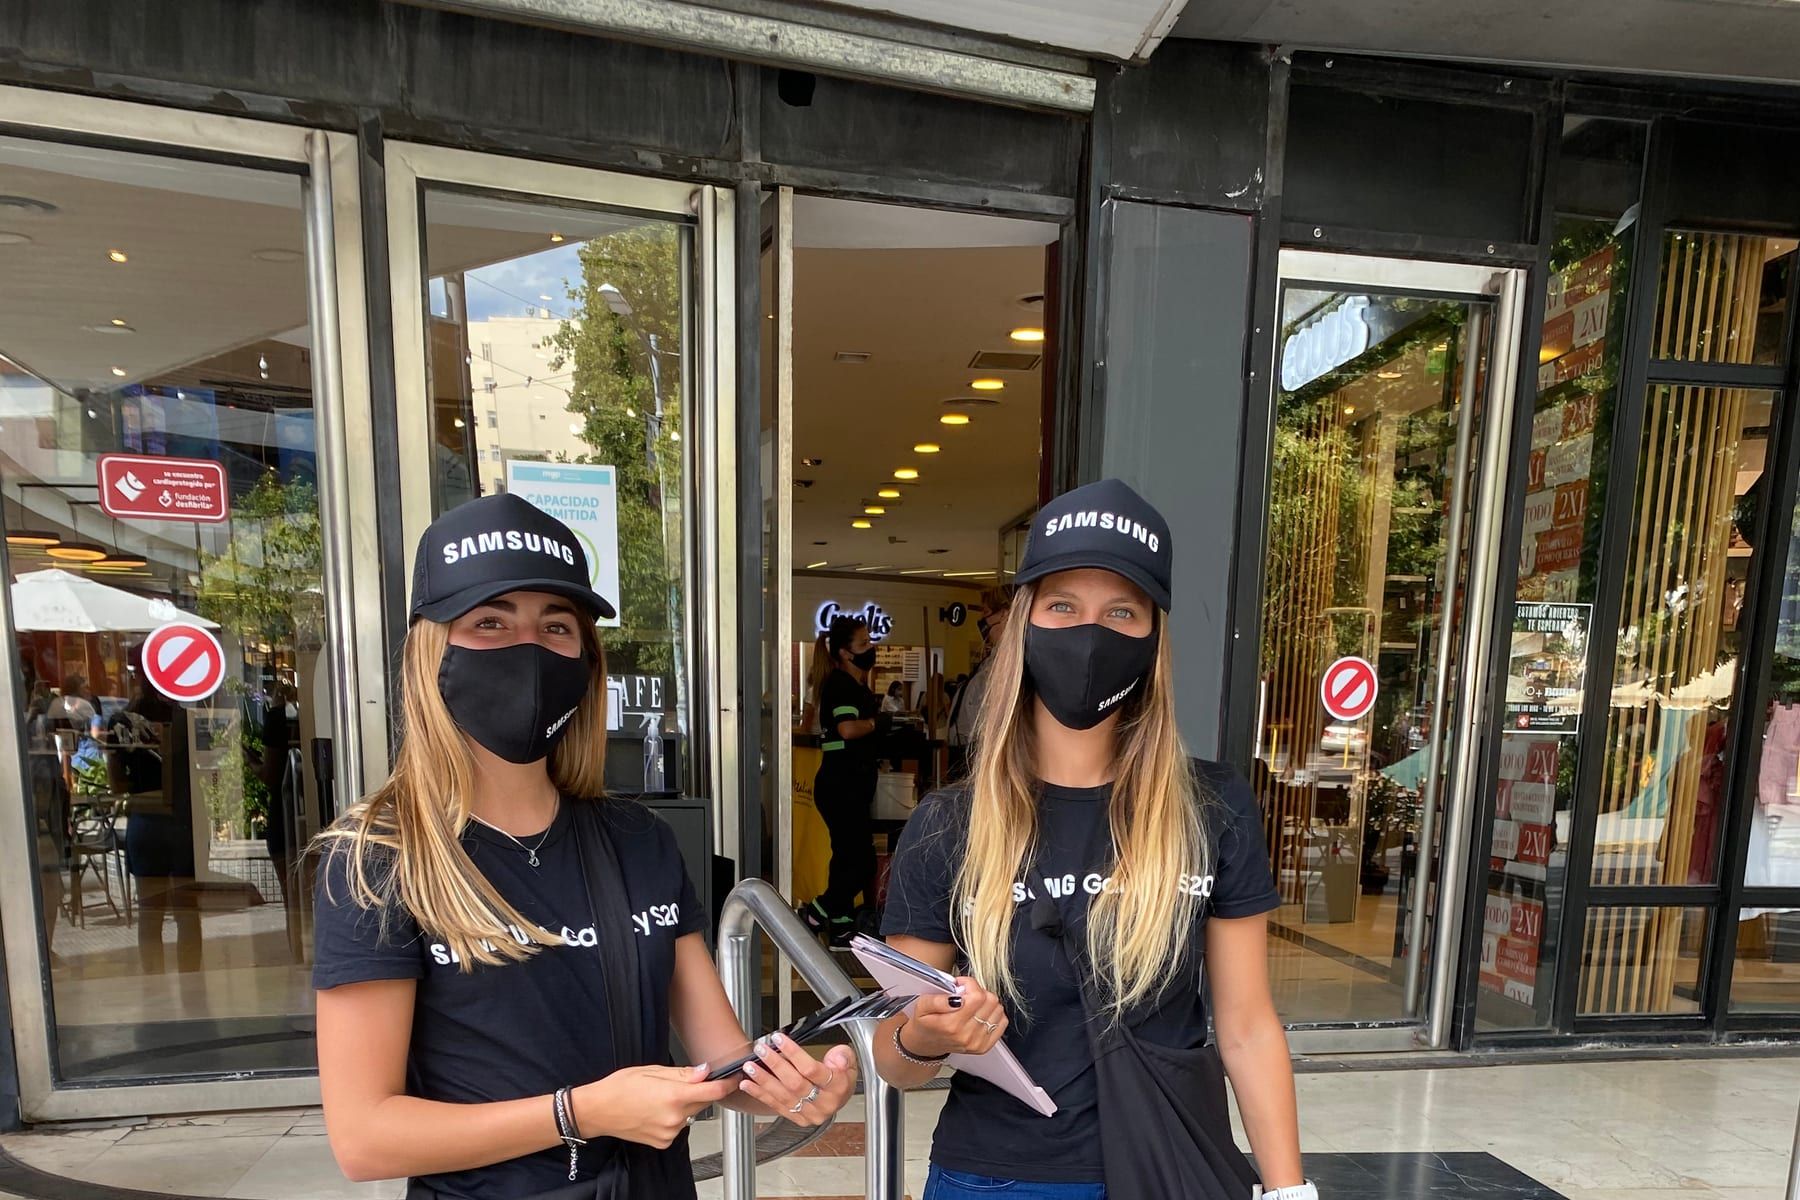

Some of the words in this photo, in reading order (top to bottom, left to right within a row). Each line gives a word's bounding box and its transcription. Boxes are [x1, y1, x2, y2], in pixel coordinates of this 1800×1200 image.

[1580, 304, 1605, 338] 2X1
[545, 508, 598, 521] RMITIDA
[1525, 503, 1550, 523] TODO
[1559, 488, 1586, 520] 2X1
[442, 530, 575, 566] SAMSUNG
[1045, 511, 1159, 553] SAMSUNG
[607, 676, 662, 708] AFE
[1531, 750, 1556, 776] 2X1
[1523, 830, 1547, 858] 2X1
[650, 902, 681, 927] S20
[1485, 905, 1509, 926] TODO
[1515, 907, 1540, 937] 2X1
